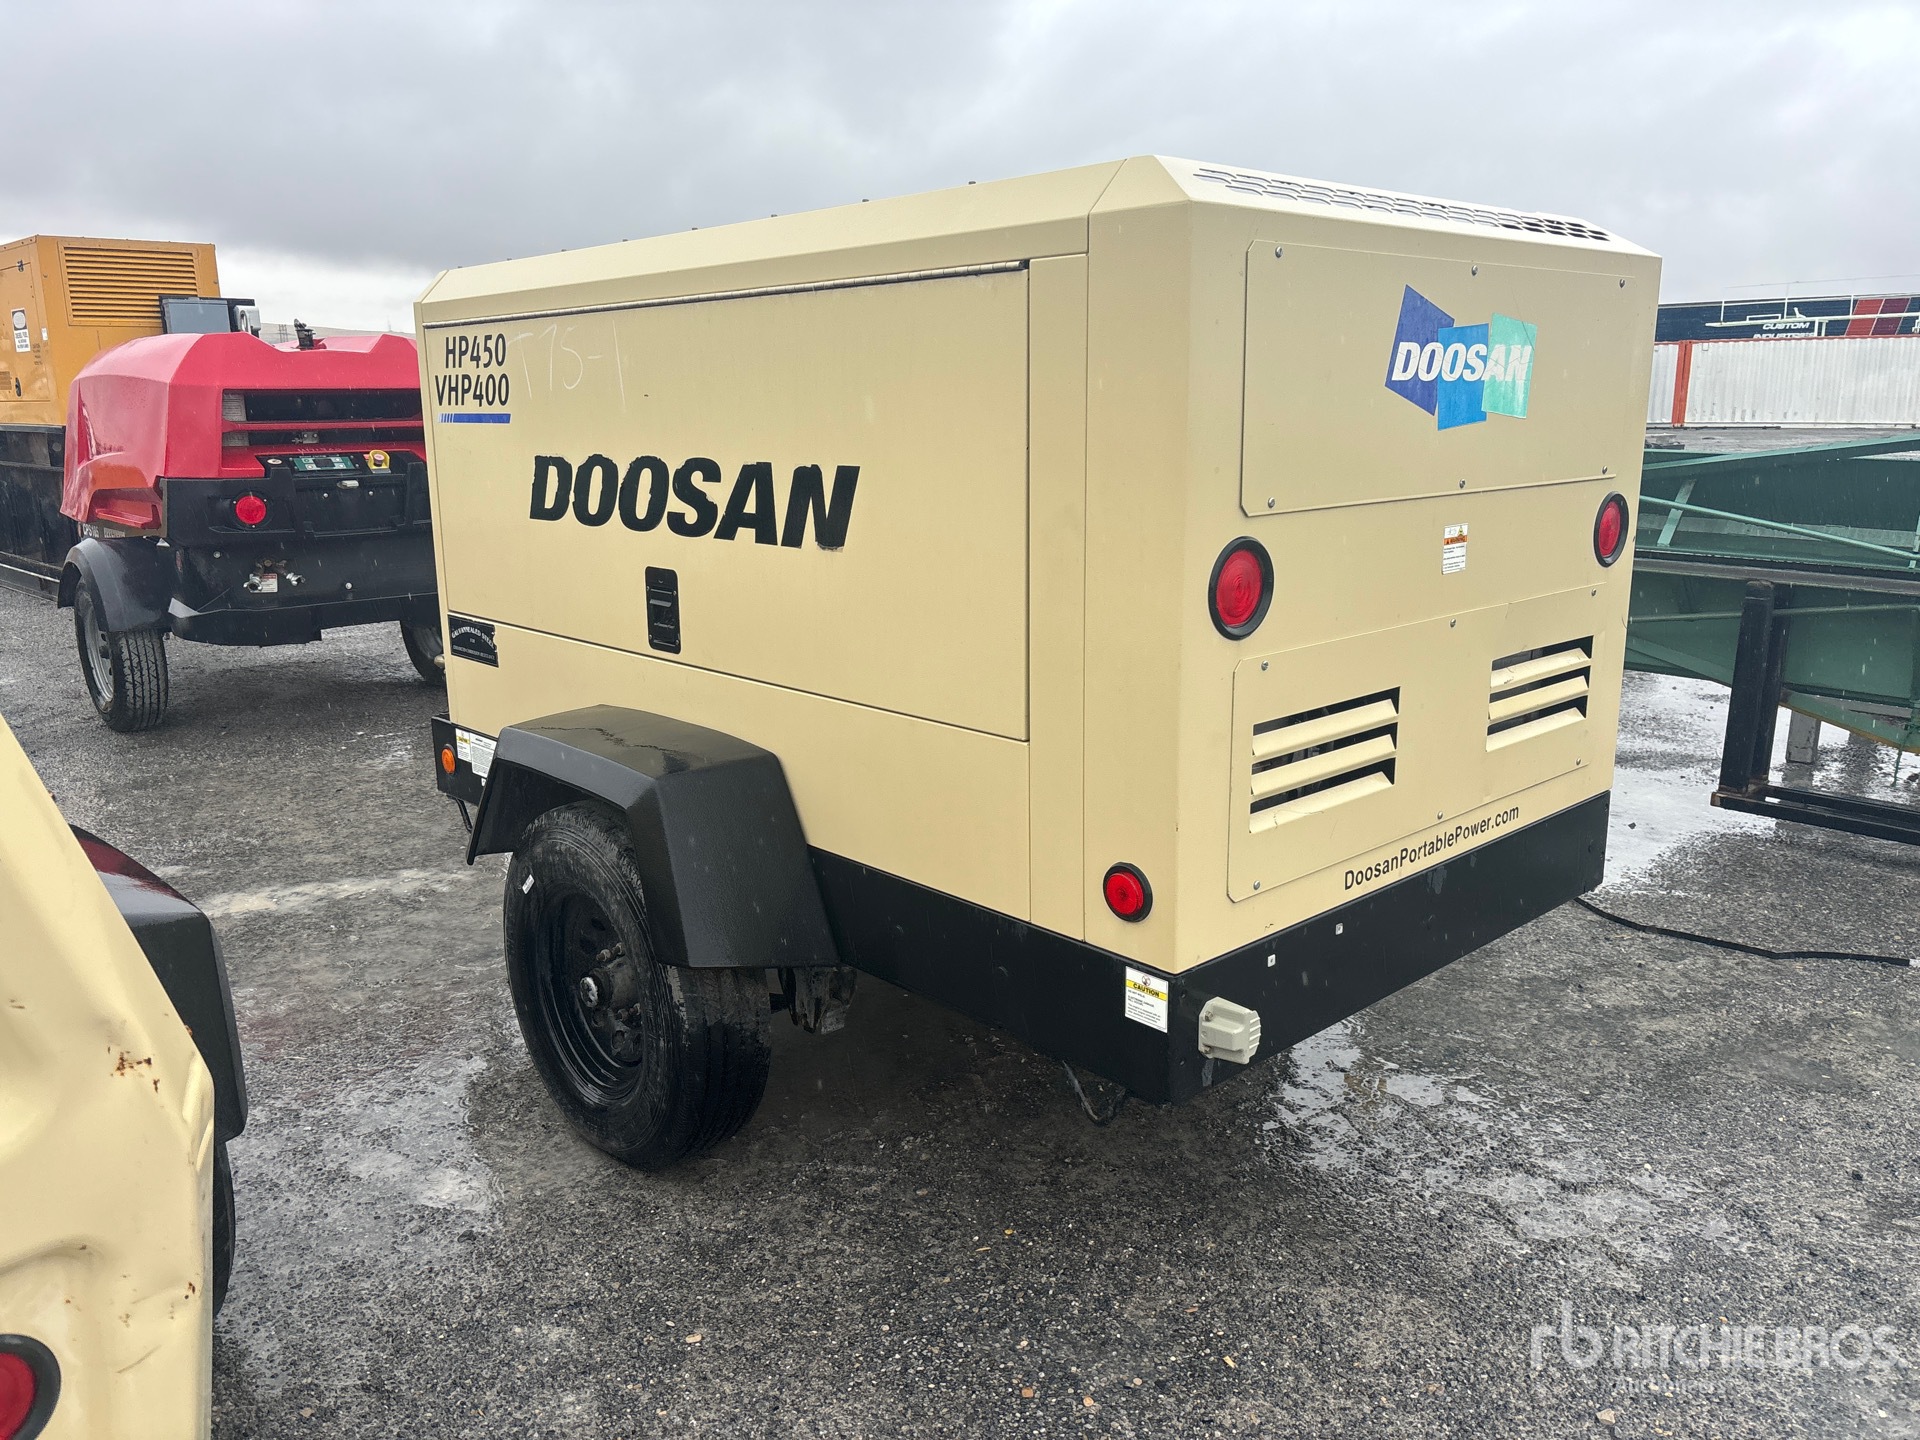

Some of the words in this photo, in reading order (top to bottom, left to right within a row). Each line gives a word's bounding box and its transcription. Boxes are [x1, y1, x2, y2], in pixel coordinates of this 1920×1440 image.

[1762, 322, 1810, 330] CUSTOM
[445, 333, 507, 369] HP450
[1391, 341, 1533, 382] DOOSAN
[434, 373, 510, 407] VHP400
[529, 453, 861, 551] DOOSAN
[1344, 806, 1519, 890] DoosanPortablePower.com
[1133, 982, 1160, 998] CAUTION
